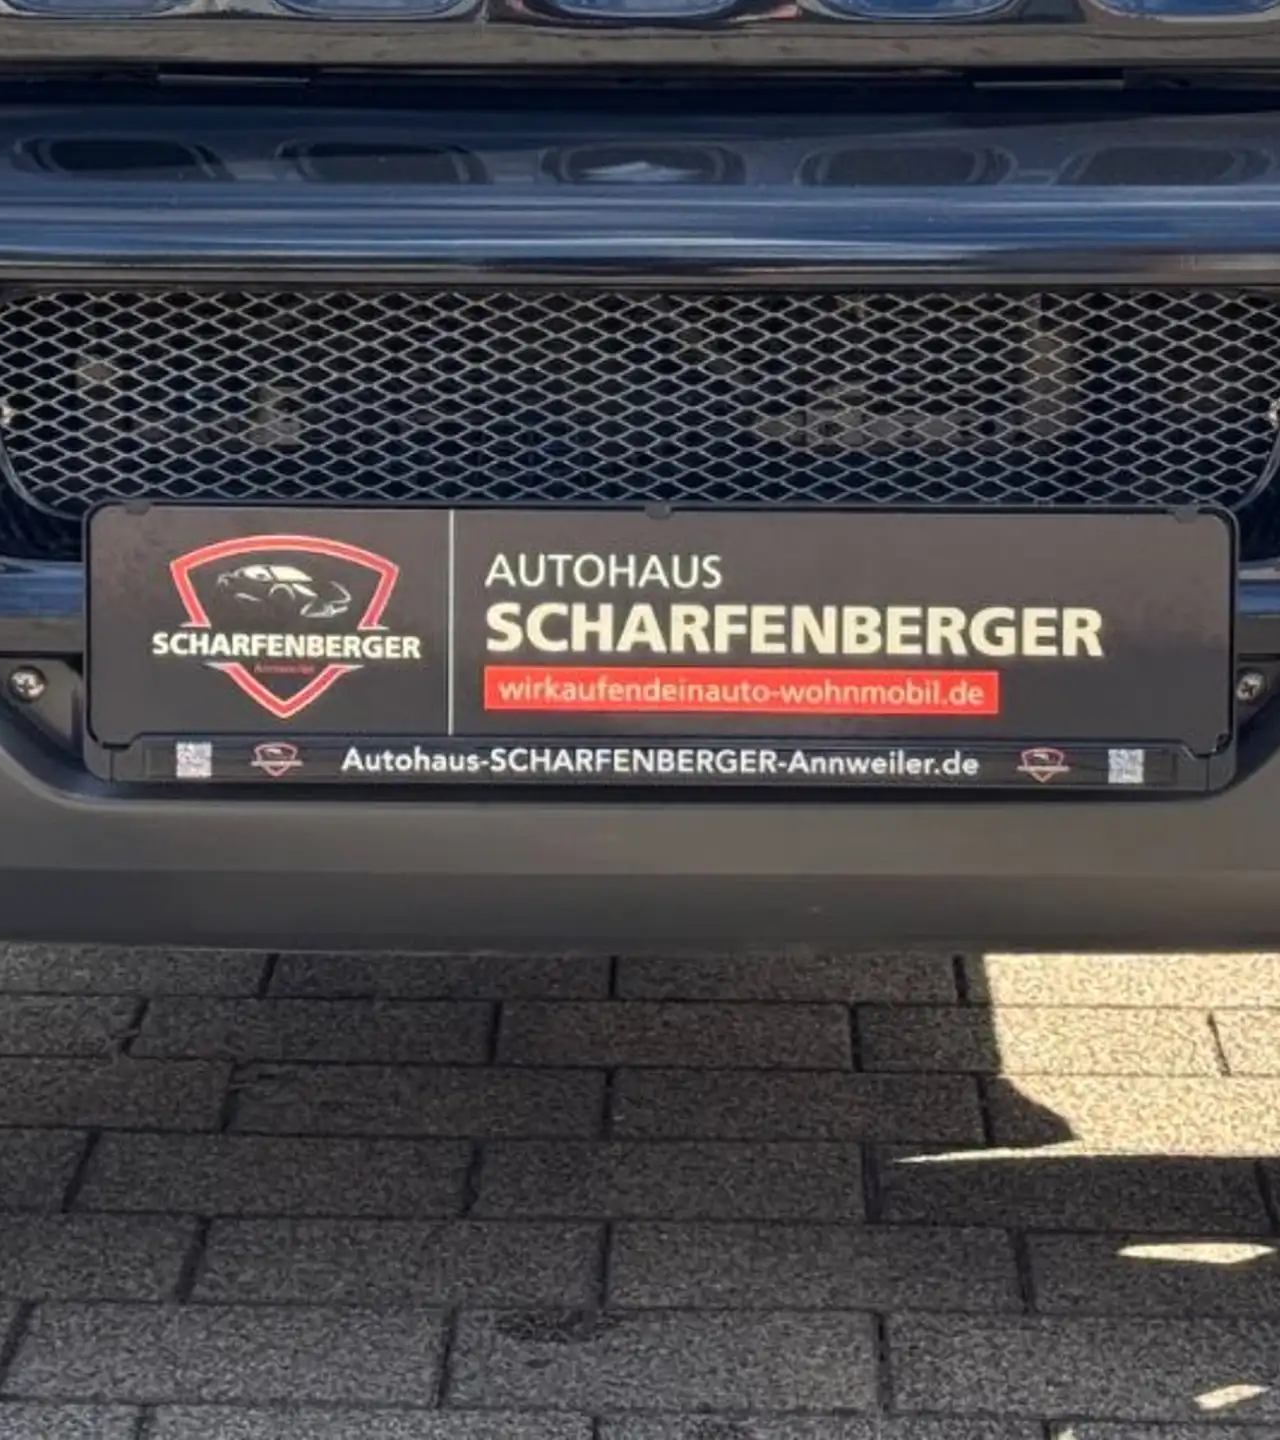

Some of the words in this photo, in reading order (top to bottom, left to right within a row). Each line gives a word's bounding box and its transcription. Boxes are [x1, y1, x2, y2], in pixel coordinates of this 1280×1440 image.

[485, 553, 722, 590] AUTOHAUS
[152, 631, 422, 660] SCHARFENBERGER
[486, 602, 1104, 658] SCHARFENBERGER
[498, 672, 986, 708] wirkaufendeinauto-wohnmobil.de
[341, 746, 981, 778] Autohaus-SCHARFENBERGER-Annweiler.de
